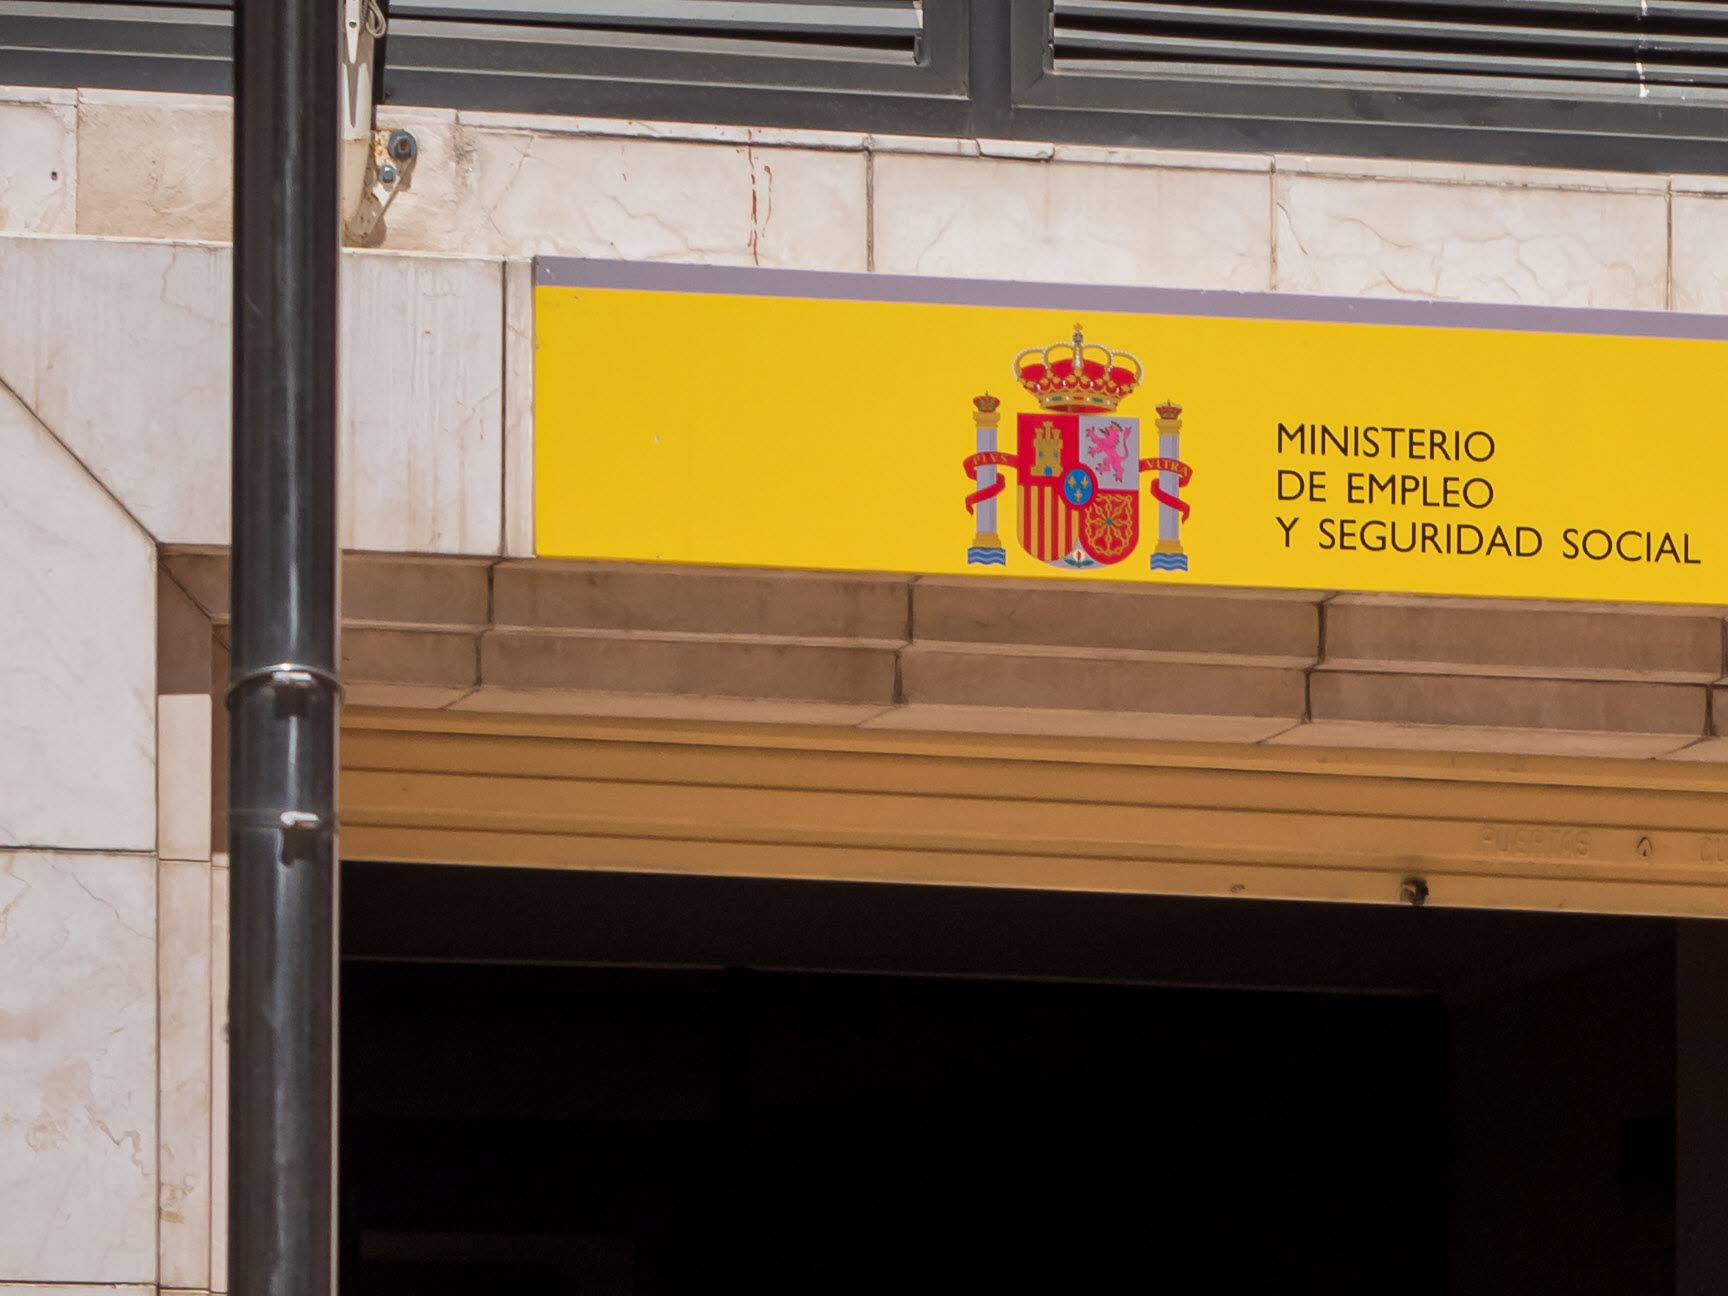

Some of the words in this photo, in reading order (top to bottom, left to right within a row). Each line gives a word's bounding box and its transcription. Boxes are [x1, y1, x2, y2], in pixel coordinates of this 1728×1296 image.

[1277, 423, 1495, 462] MINISTERIO
[1277, 469, 1326, 502] DE
[1347, 472, 1494, 509] EMPLEO
[1276, 516, 1299, 547] Y
[1319, 518, 1543, 557] SEGURIDAD
[1563, 528, 1702, 564] SOCIAL
